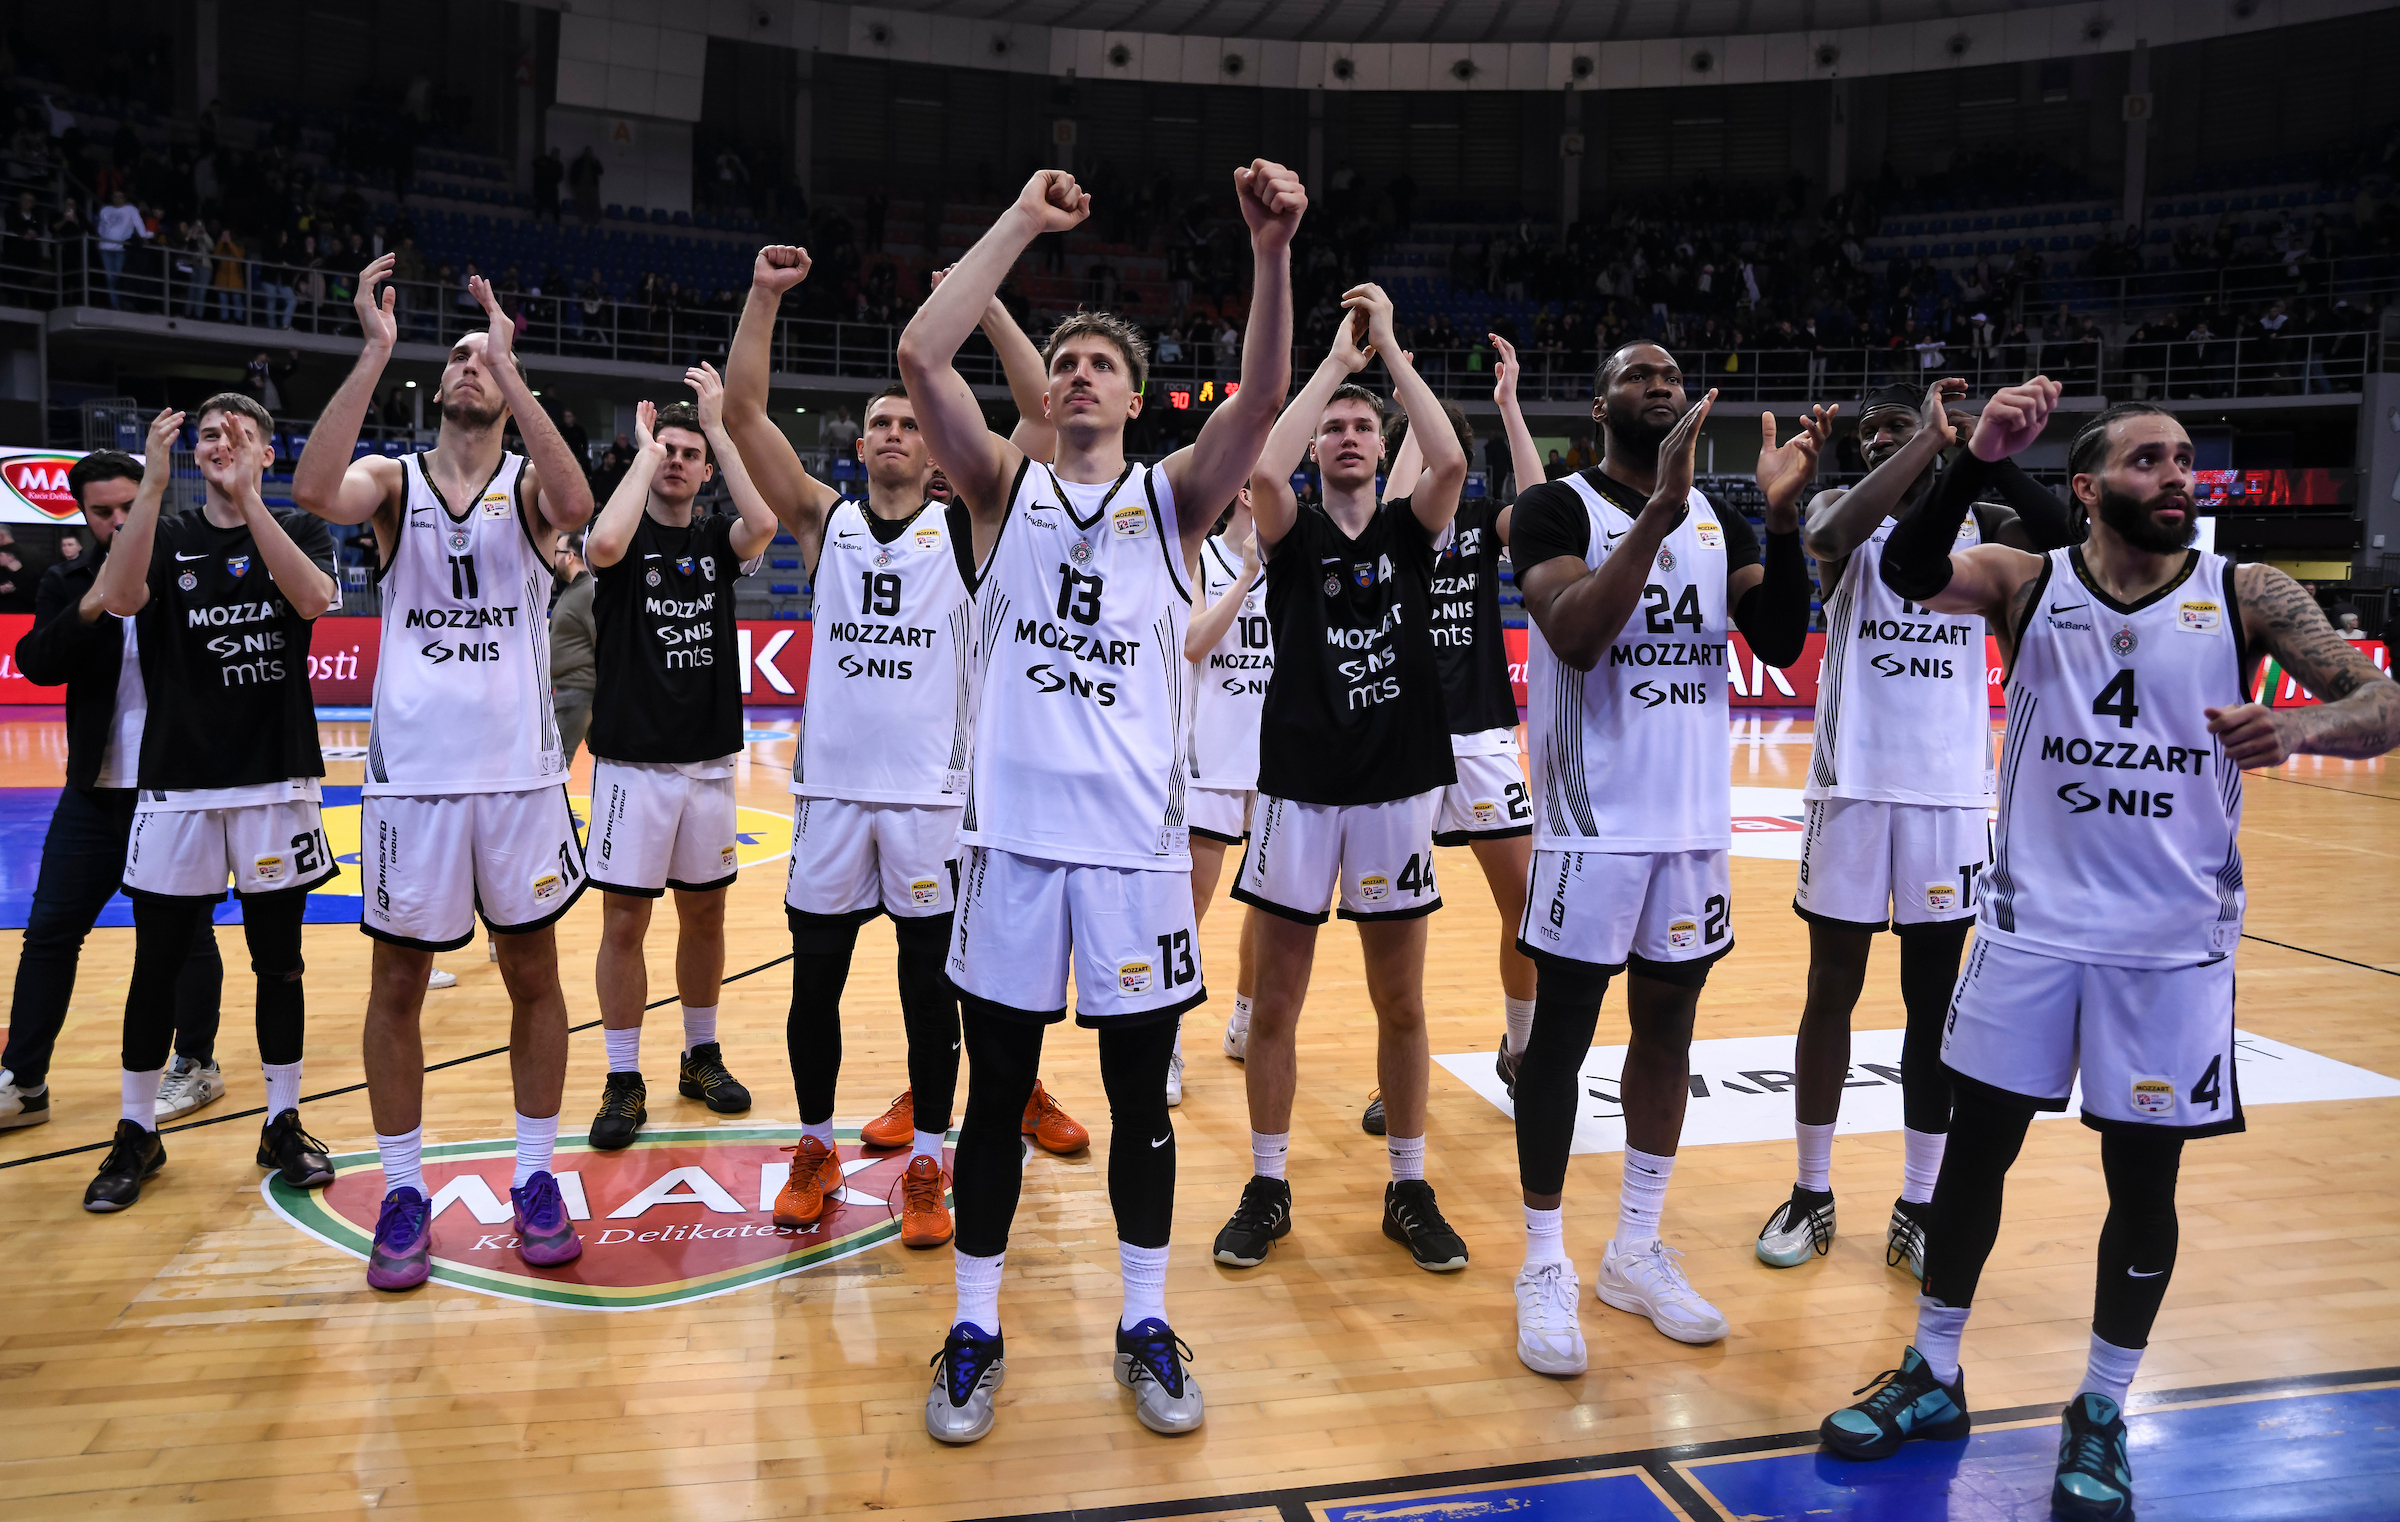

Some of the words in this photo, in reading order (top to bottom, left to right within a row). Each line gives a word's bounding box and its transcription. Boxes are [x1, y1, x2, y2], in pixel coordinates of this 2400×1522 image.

[19, 466, 71, 491] MA
[1114, 510, 1142, 519] MOZZART
[448, 554, 479, 600] 11
[698, 555, 717, 581] 8
[645, 593, 716, 618] MOZZAR
[860, 571, 902, 617] 19
[1056, 562, 1103, 626] 13
[1642, 584, 1702, 634] 24
[188, 598, 286, 629] MOZZAR
[405, 606, 519, 629] MOZZART
[1442, 601, 1474, 620] NIS
[243, 630, 287, 653] NIS
[684, 621, 713, 643] NIS
[829, 622, 937, 648] MOZZART
[1014, 618, 1140, 667] MOZZART
[1237, 616, 1268, 649] 10
[1858, 619, 1971, 646] MOZZART
[458, 641, 500, 662] NIS
[666, 645, 714, 669] mts
[1210, 654, 1273, 669] MOZZA
[1609, 643, 1725, 667] MOZZART
[222, 656, 287, 687] mts
[867, 657, 912, 680] NIS
[1910, 657, 1954, 679] NIS
[1248, 679, 1267, 694] NI
[1348, 677, 1400, 710] mts
[1669, 682, 1707, 705] NIS
[2091, 668, 2139, 729] 4
[2041, 735, 2209, 776] MOZZART
[605, 783, 619, 839] MILSPED
[2107, 788, 2174, 819] NIS
[1261, 796, 1276, 850] MILSPE
[290, 827, 326, 875] 21
[379, 820, 388, 888] MILSPED
[391, 826, 399, 864] GROUP
[974, 852, 988, 898] GROUP
[1396, 850, 1435, 897] 44
[1540, 925, 1561, 942] mts
[1121, 965, 1148, 974] MOZZART
[1157, 927, 1197, 990] 13
[2190, 1054, 2221, 1112] 4
